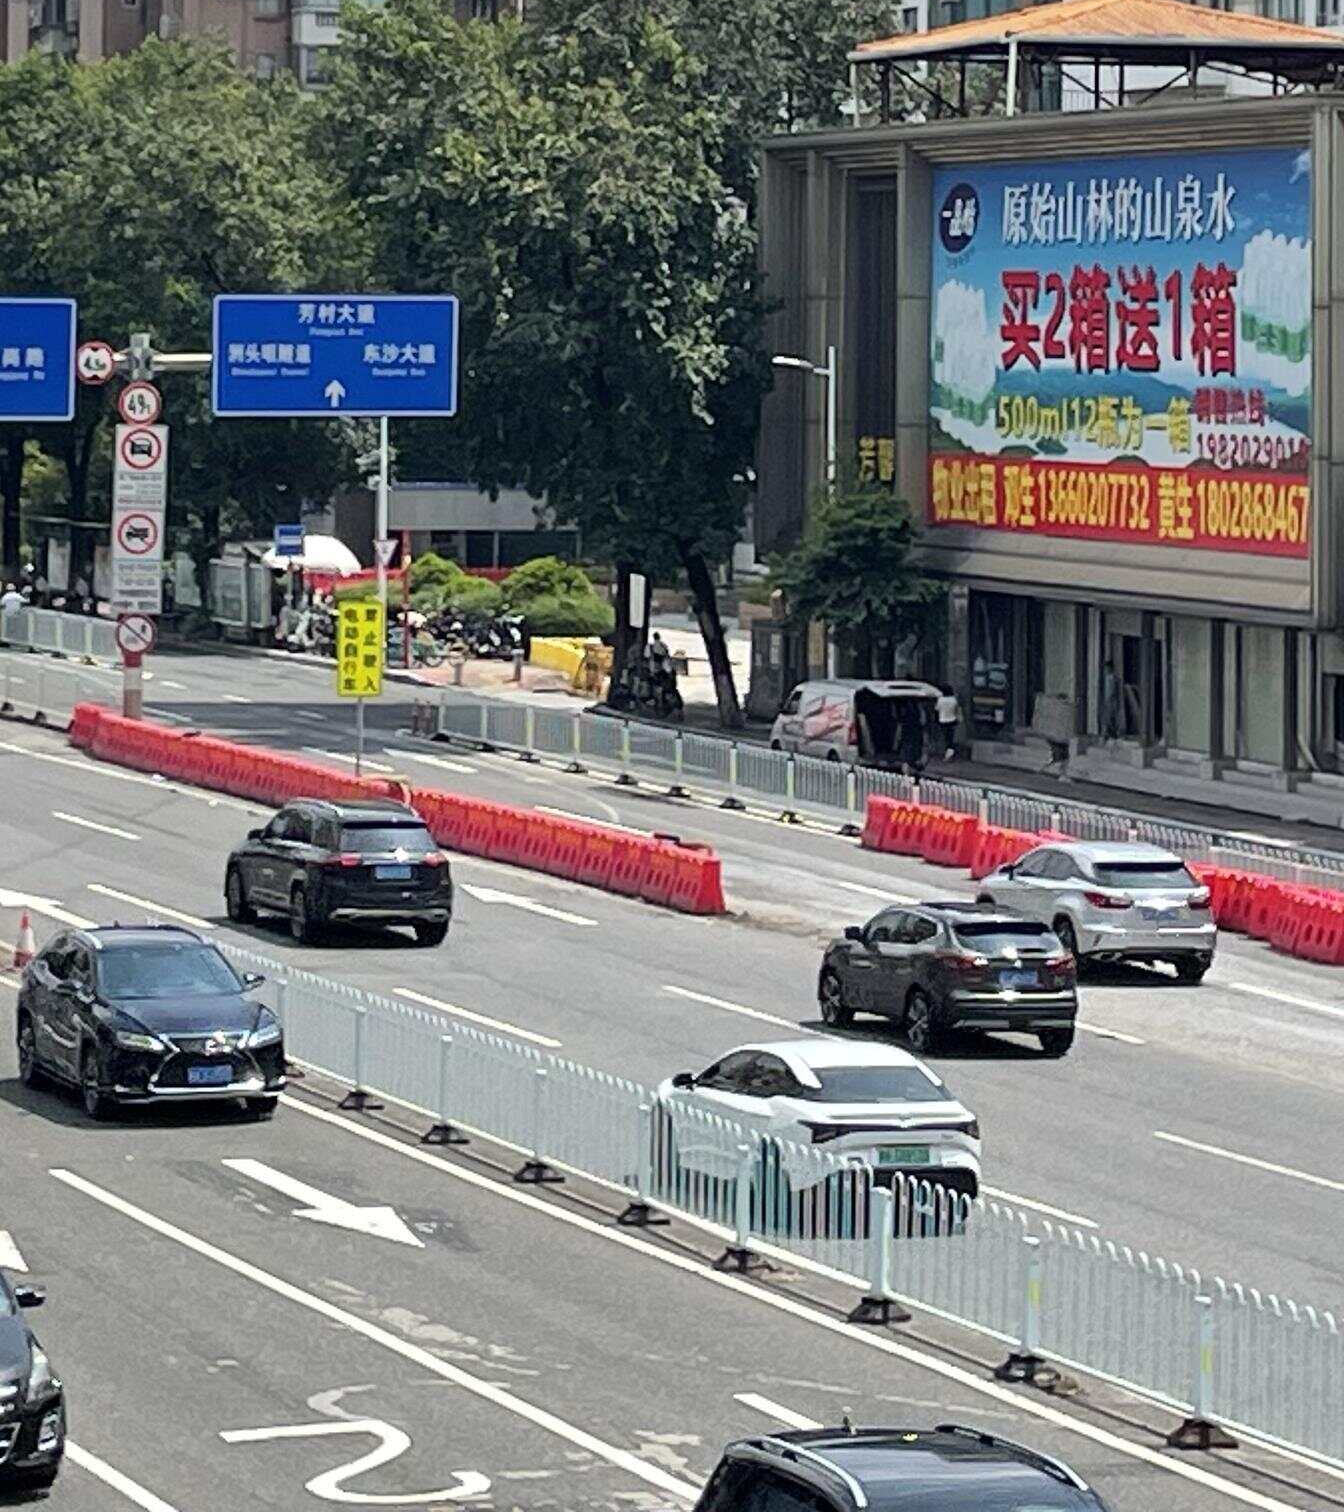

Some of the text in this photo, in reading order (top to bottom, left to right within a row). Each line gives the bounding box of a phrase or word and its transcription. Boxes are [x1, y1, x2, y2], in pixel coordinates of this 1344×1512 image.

[1002, 172, 1237, 247] 原始山林的山泉水
[1000, 262, 1238, 377] 买2箱送1箱
